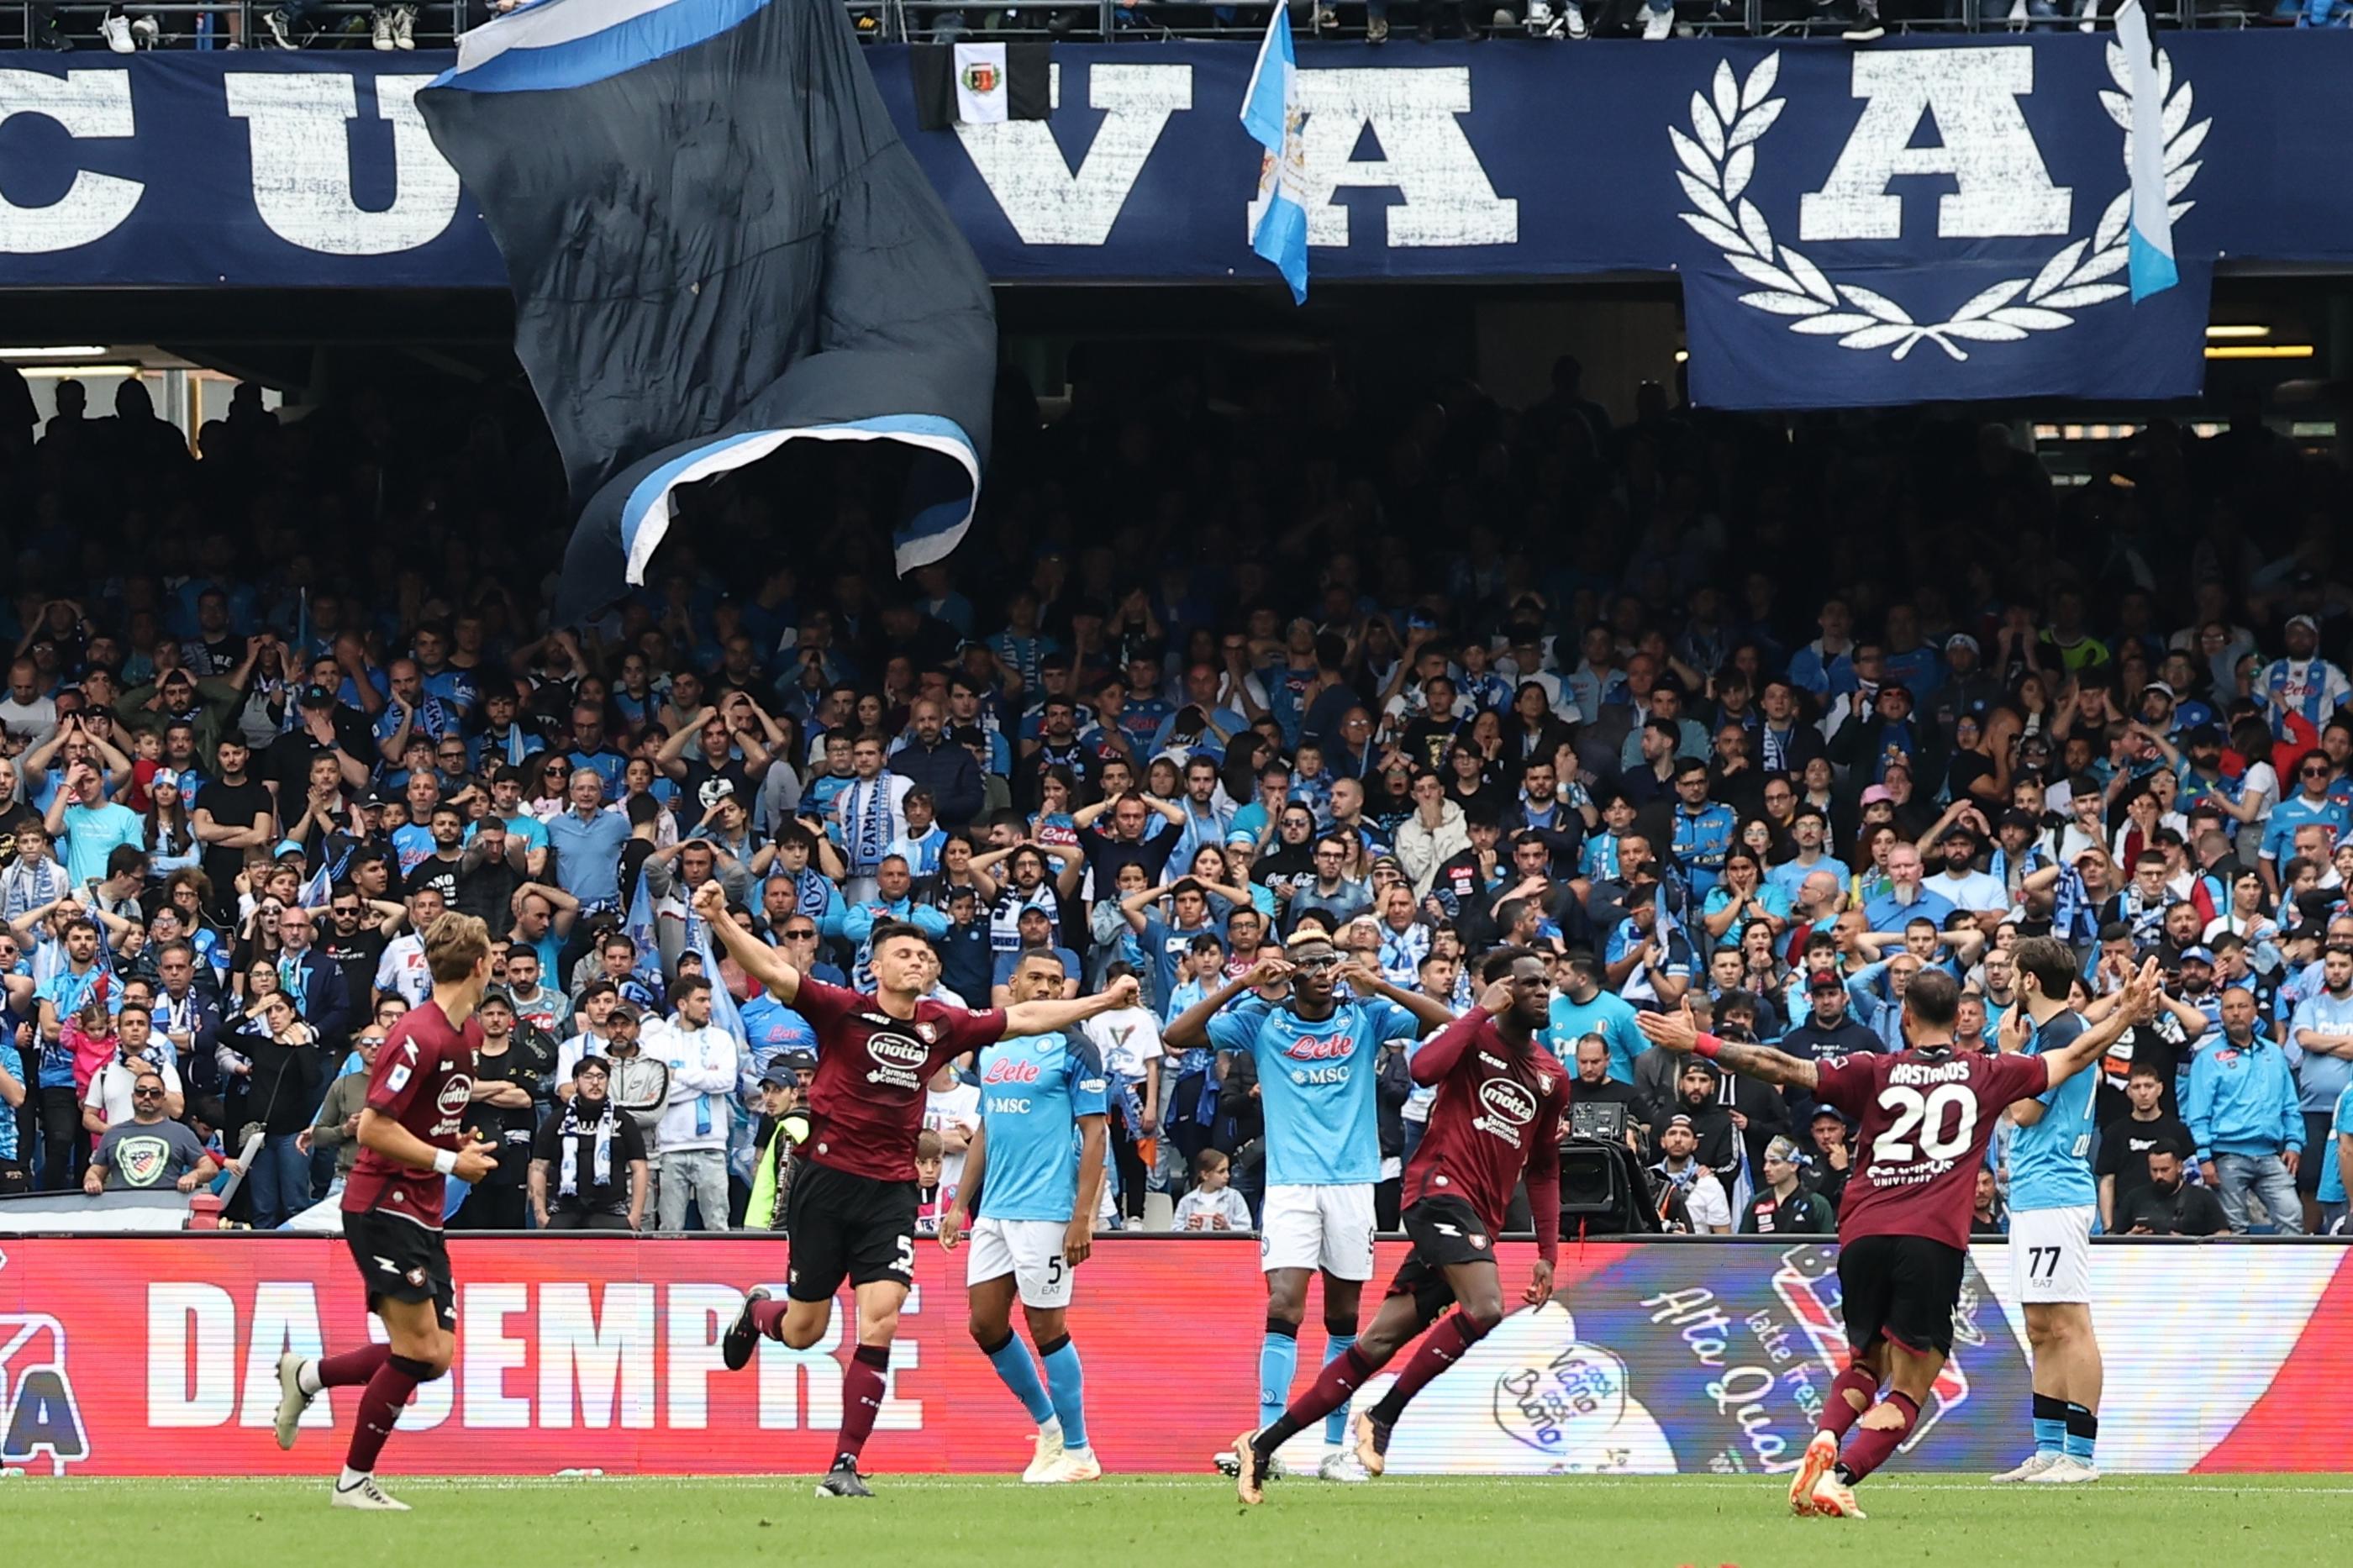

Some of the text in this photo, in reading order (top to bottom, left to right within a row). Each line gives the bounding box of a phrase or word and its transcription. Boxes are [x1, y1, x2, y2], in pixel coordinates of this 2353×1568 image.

[1799, 45, 2072, 241] A
[1282, 1032, 1354, 1062] Lete
[982, 1056, 1040, 1085] Lete
[1308, 1066, 1350, 1084] MSC
[995, 1097, 1031, 1114] MSC
[1484, 1087, 1533, 1120] motta
[1872, 1082, 1978, 1163] 20
[897, 1234, 914, 1266] 5
[2029, 1246, 2061, 1278] 77
[1047, 1255, 1062, 1285] 5
[2032, 1279, 2054, 1288] EA7
[1042, 1286, 1061, 1295] EA7
[148, 1281, 334, 1429] DA
